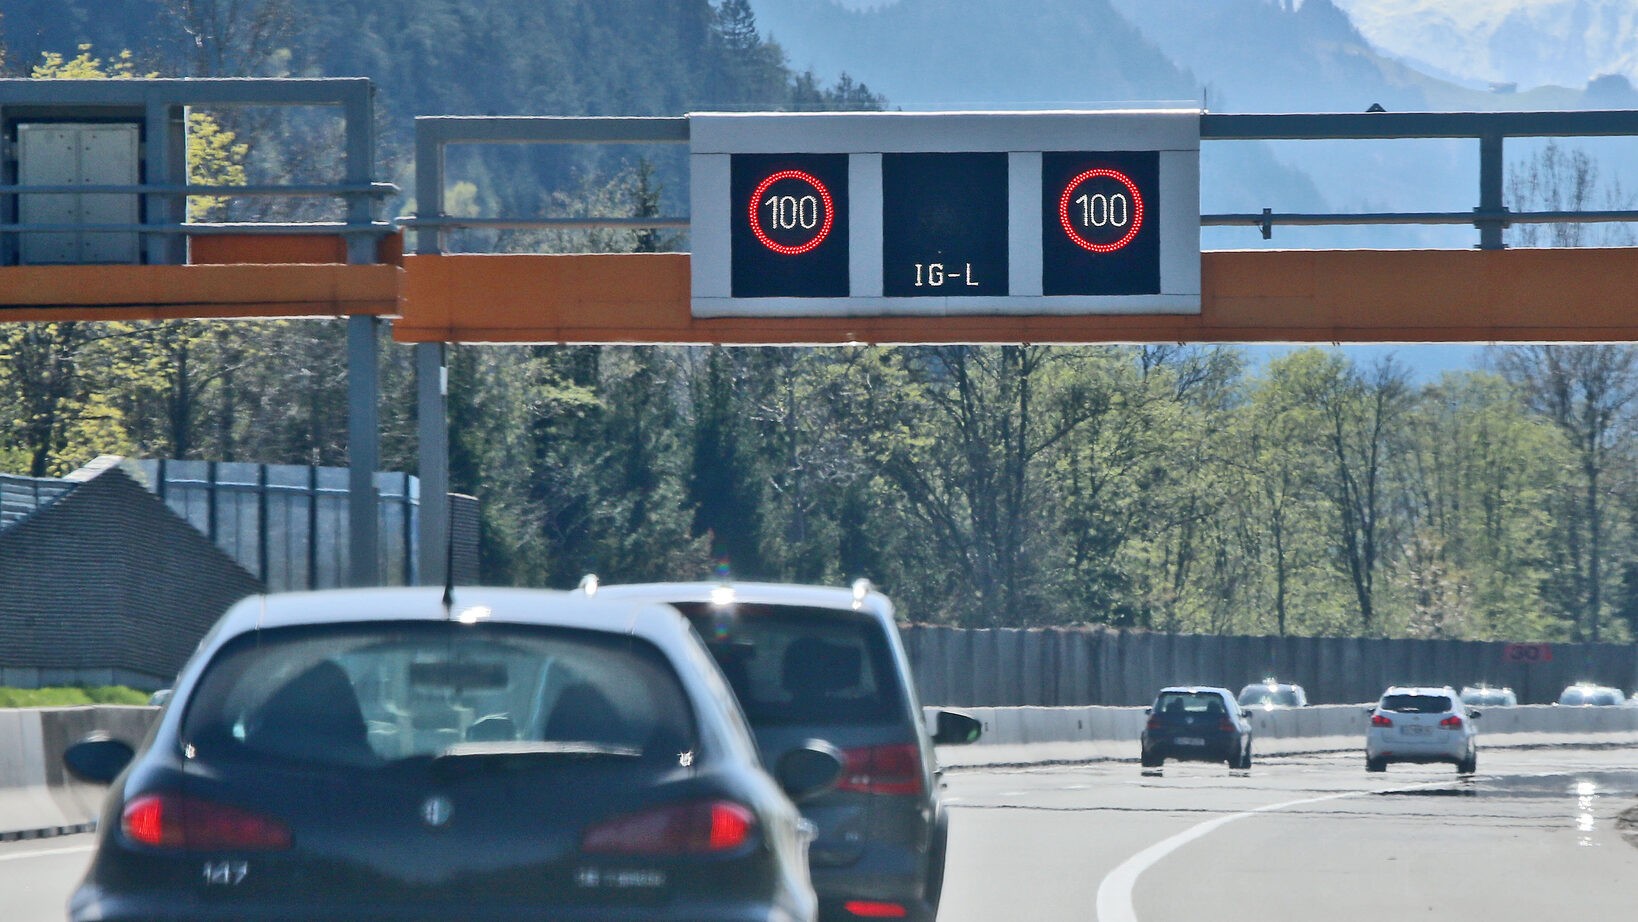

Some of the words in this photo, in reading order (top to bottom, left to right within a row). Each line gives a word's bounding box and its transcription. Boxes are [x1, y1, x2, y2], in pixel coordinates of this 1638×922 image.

[765, 195, 818, 229] 100
[1075, 193, 1128, 227] 100
[914, 263, 979, 286] IG-L
[202, 861, 248, 886] 147
